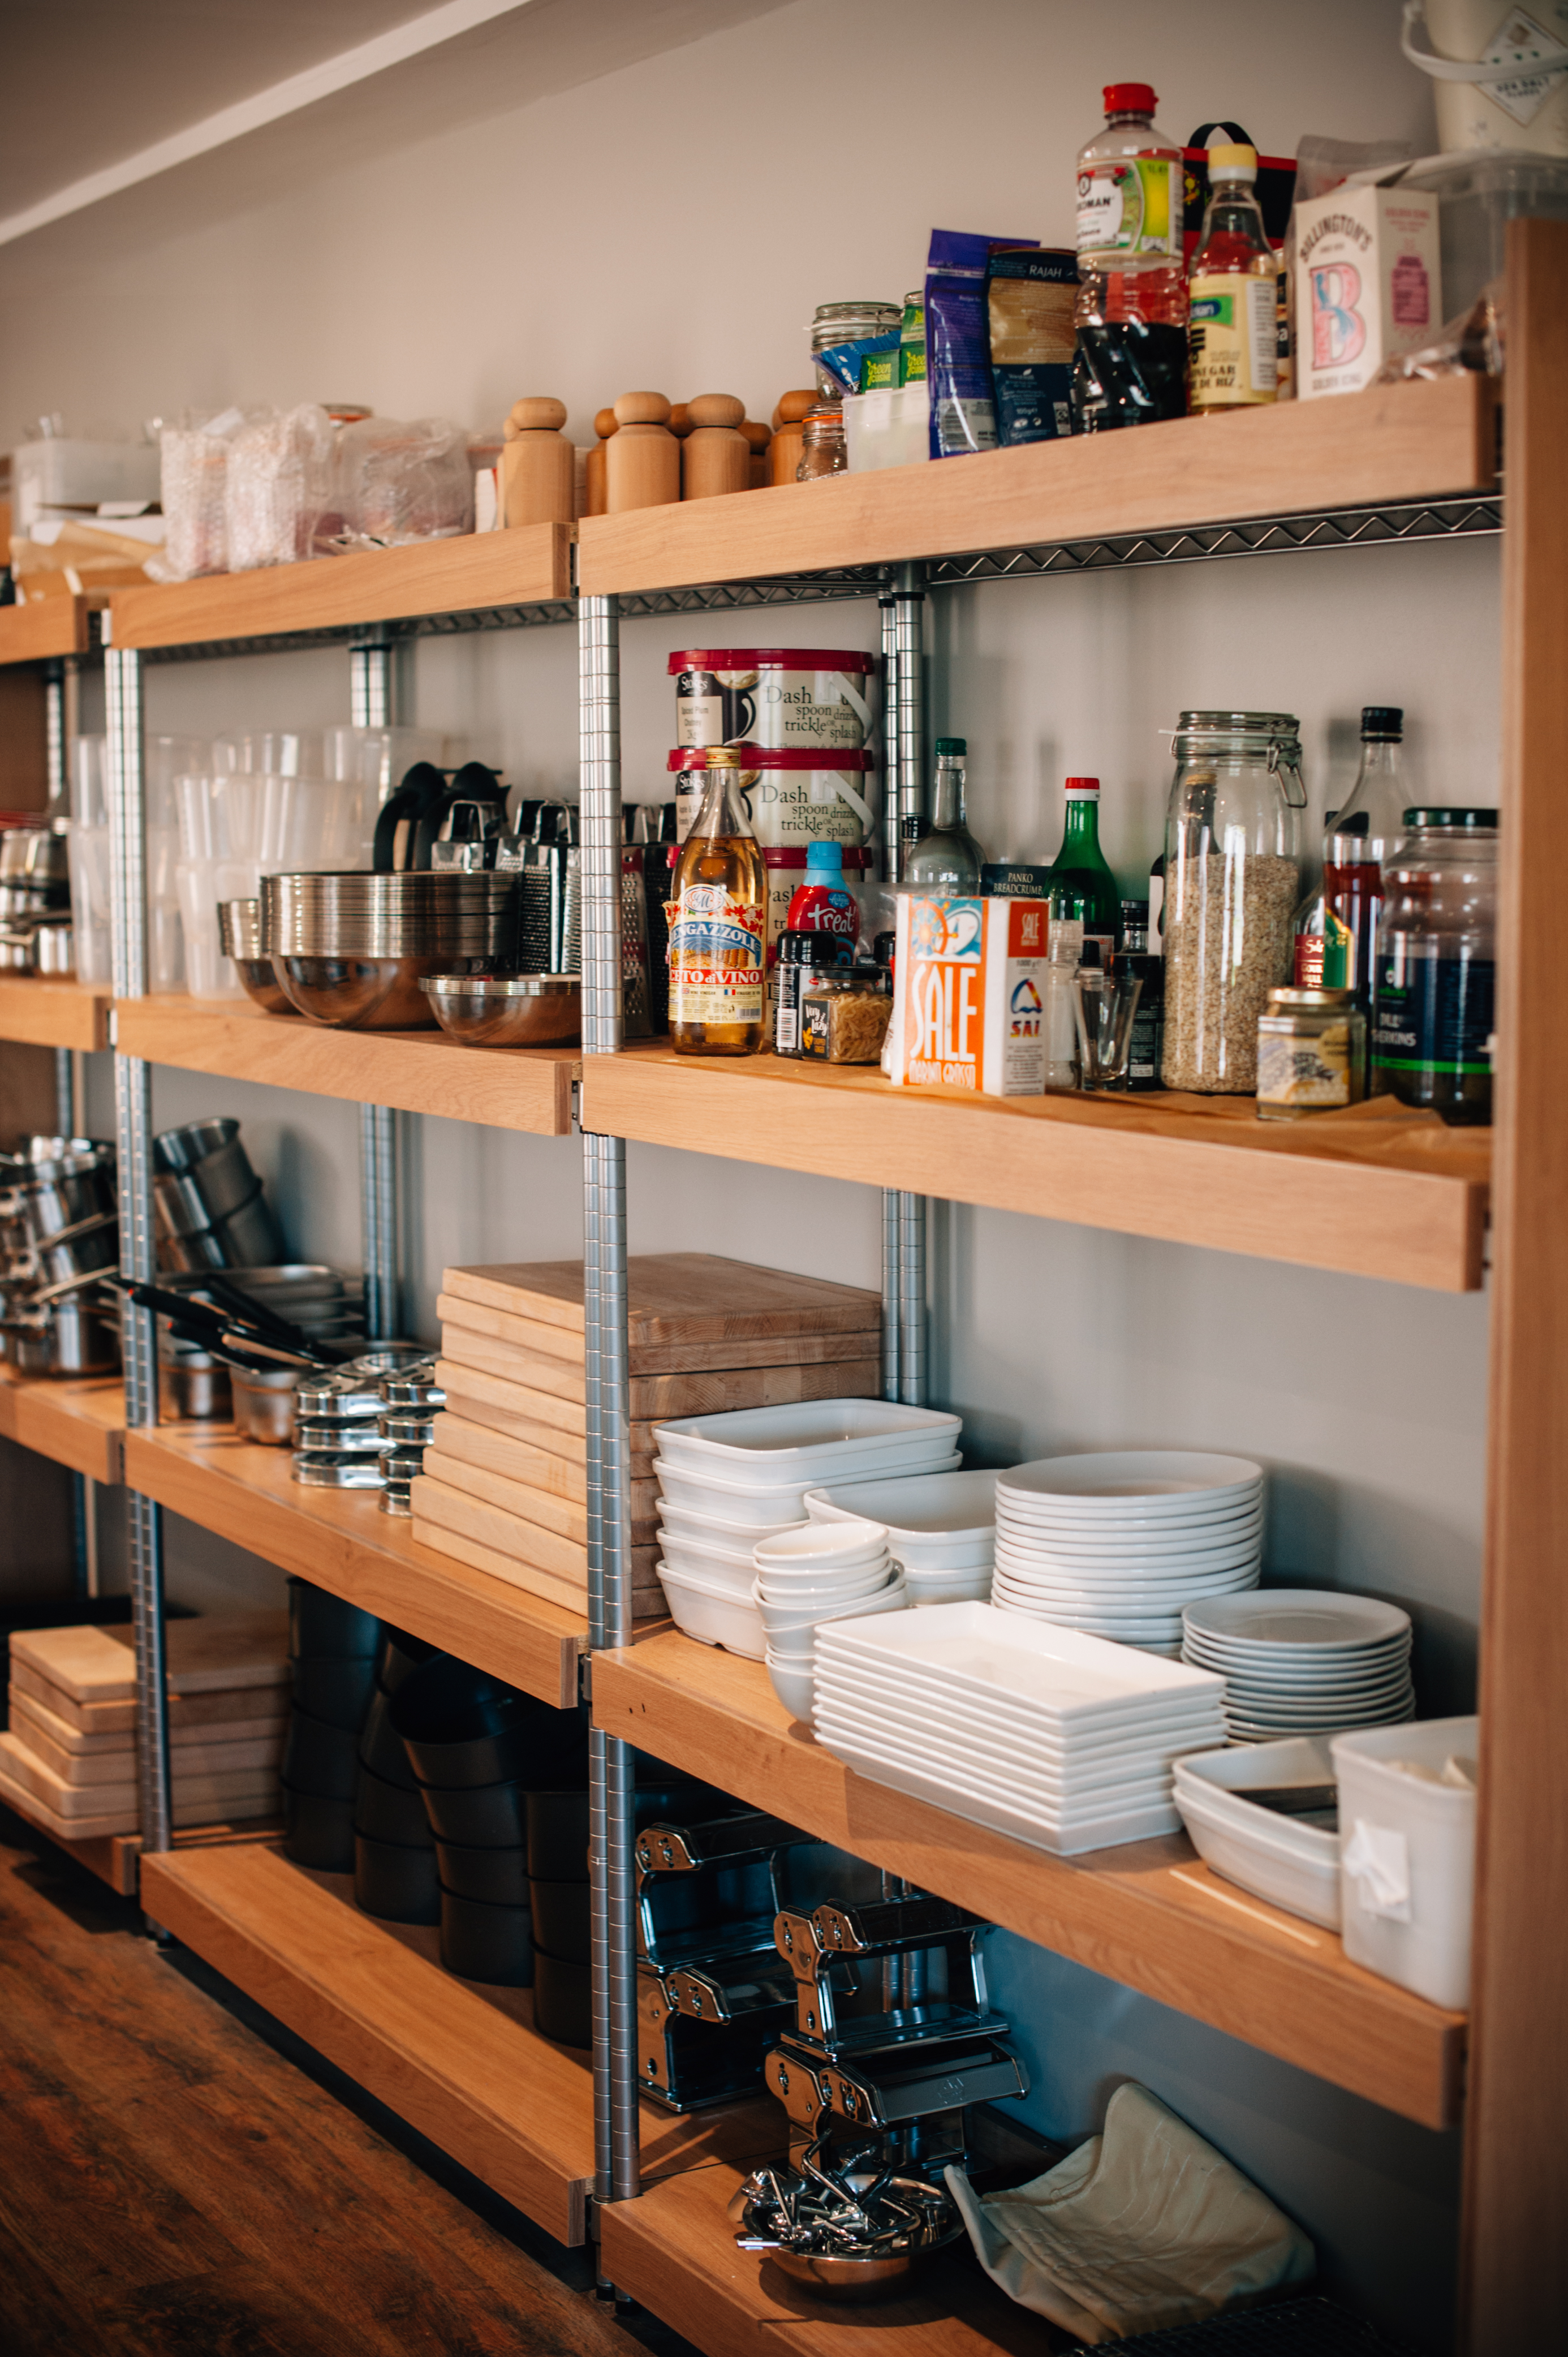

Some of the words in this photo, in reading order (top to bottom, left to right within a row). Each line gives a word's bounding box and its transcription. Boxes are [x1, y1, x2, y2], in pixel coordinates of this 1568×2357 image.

[1029, 265, 1062, 278] RAJAH
[765, 686, 812, 703] Dash
[796, 706, 832, 720] spoon
[785, 717, 826, 738] trickle
[830, 725, 856, 742] splash
[761, 785, 808, 803] Dash
[792, 806, 829, 819] spoon
[782, 816, 823, 837] trickle
[826, 824, 855, 841] splash
[1007, 872, 1033, 884] PANKO
[769, 885, 796, 902] ash
[993, 882, 1043, 895] BREADCRUMB
[673, 923, 756, 952] ENGAZZOLI
[670, 969, 704, 983] CETO
[705, 973, 716, 983] di
[715, 970, 760, 983] VINO
[805, 1004, 820, 1021] Very
[910, 963, 977, 1062] SALE
[811, 1019, 828, 1036] Lazy
